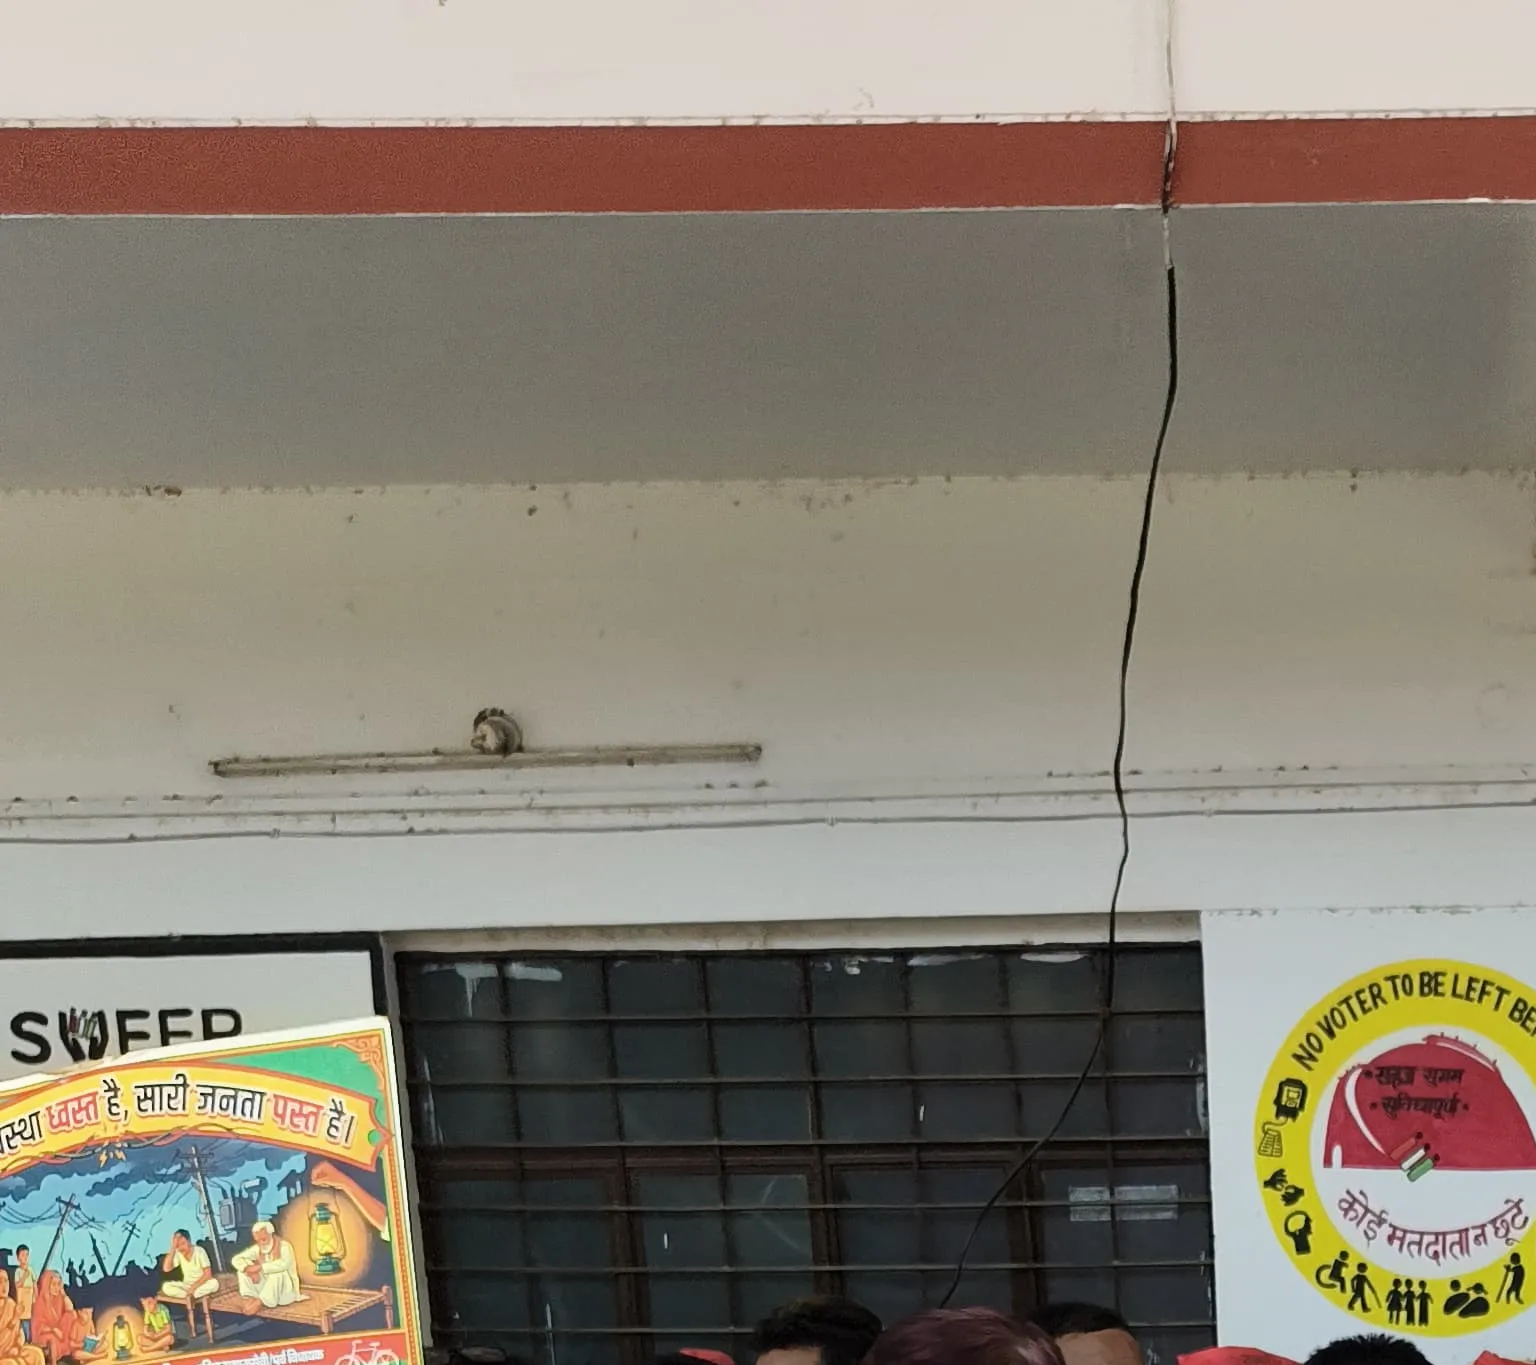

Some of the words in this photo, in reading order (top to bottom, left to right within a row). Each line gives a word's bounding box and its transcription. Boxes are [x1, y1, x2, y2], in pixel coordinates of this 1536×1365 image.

[1291, 1032, 1324, 1072] NO
[1316, 982, 1389, 1041] VOTER
[1384, 973, 1414, 1001] TO
[1419, 970, 1447, 998] BE
[1451, 972, 1512, 1013] LEFT
[46, 1091, 99, 1130] ध्वस्त
[103, 1078, 129, 1121] है,
[135, 1073, 189, 1114] सारी
[196, 1084, 266, 1120] जनता
[273, 1094, 325, 1134] पस्त
[327, 1098, 355, 1143] है।
[1337, 1188, 1389, 1247] कोई
[1386, 1221, 1471, 1267] मतदाता
[1470, 1223, 1489, 1247] न
